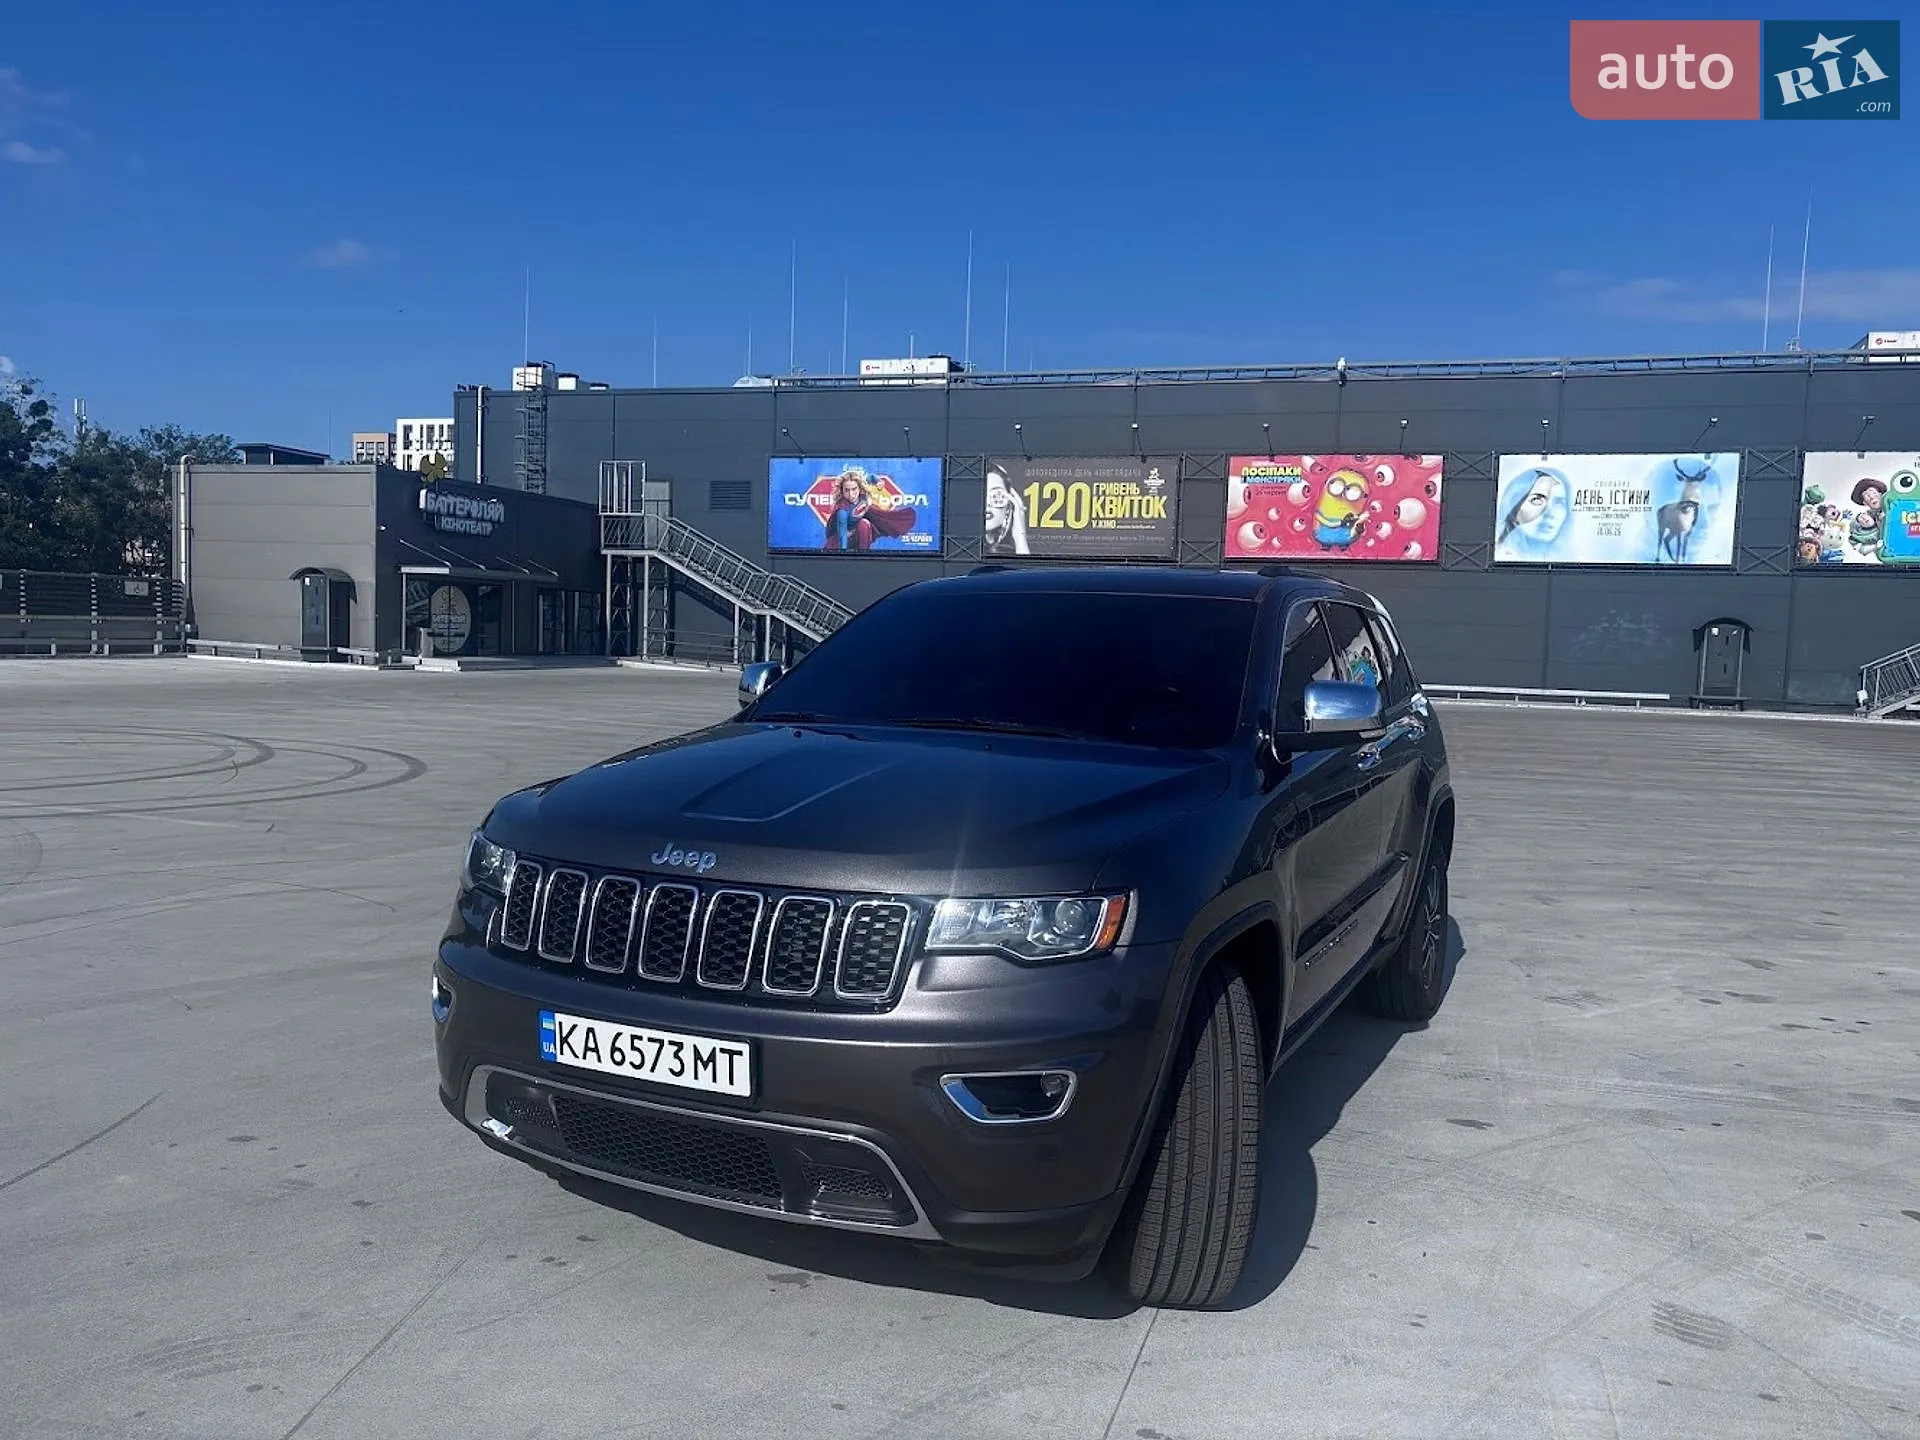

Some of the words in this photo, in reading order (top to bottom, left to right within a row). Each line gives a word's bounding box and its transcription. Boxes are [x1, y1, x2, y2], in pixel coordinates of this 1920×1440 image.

[1241, 466, 1301, 476] ПОСІПАКИ
[1093, 482, 1140, 496] ГРИВЕНЬ
[1574, 489, 1604, 506] ДЕНЬ
[1609, 489, 1650, 505] ІСТИНИ
[426, 492, 504, 522] БАТТЕРФЛЯЙ
[784, 493, 928, 507] СУПЕЬОРЛ
[1024, 481, 1091, 530] 120
[1092, 496, 1167, 519] КВИТОК
[441, 516, 492, 537] КІНОТЕАТР
[651, 842, 717, 874] Jeep
[543, 1041, 555, 1053] UA
[558, 1021, 602, 1064] KA
[610, 1032, 685, 1077] 6573
[693, 1044, 743, 1086] MT
